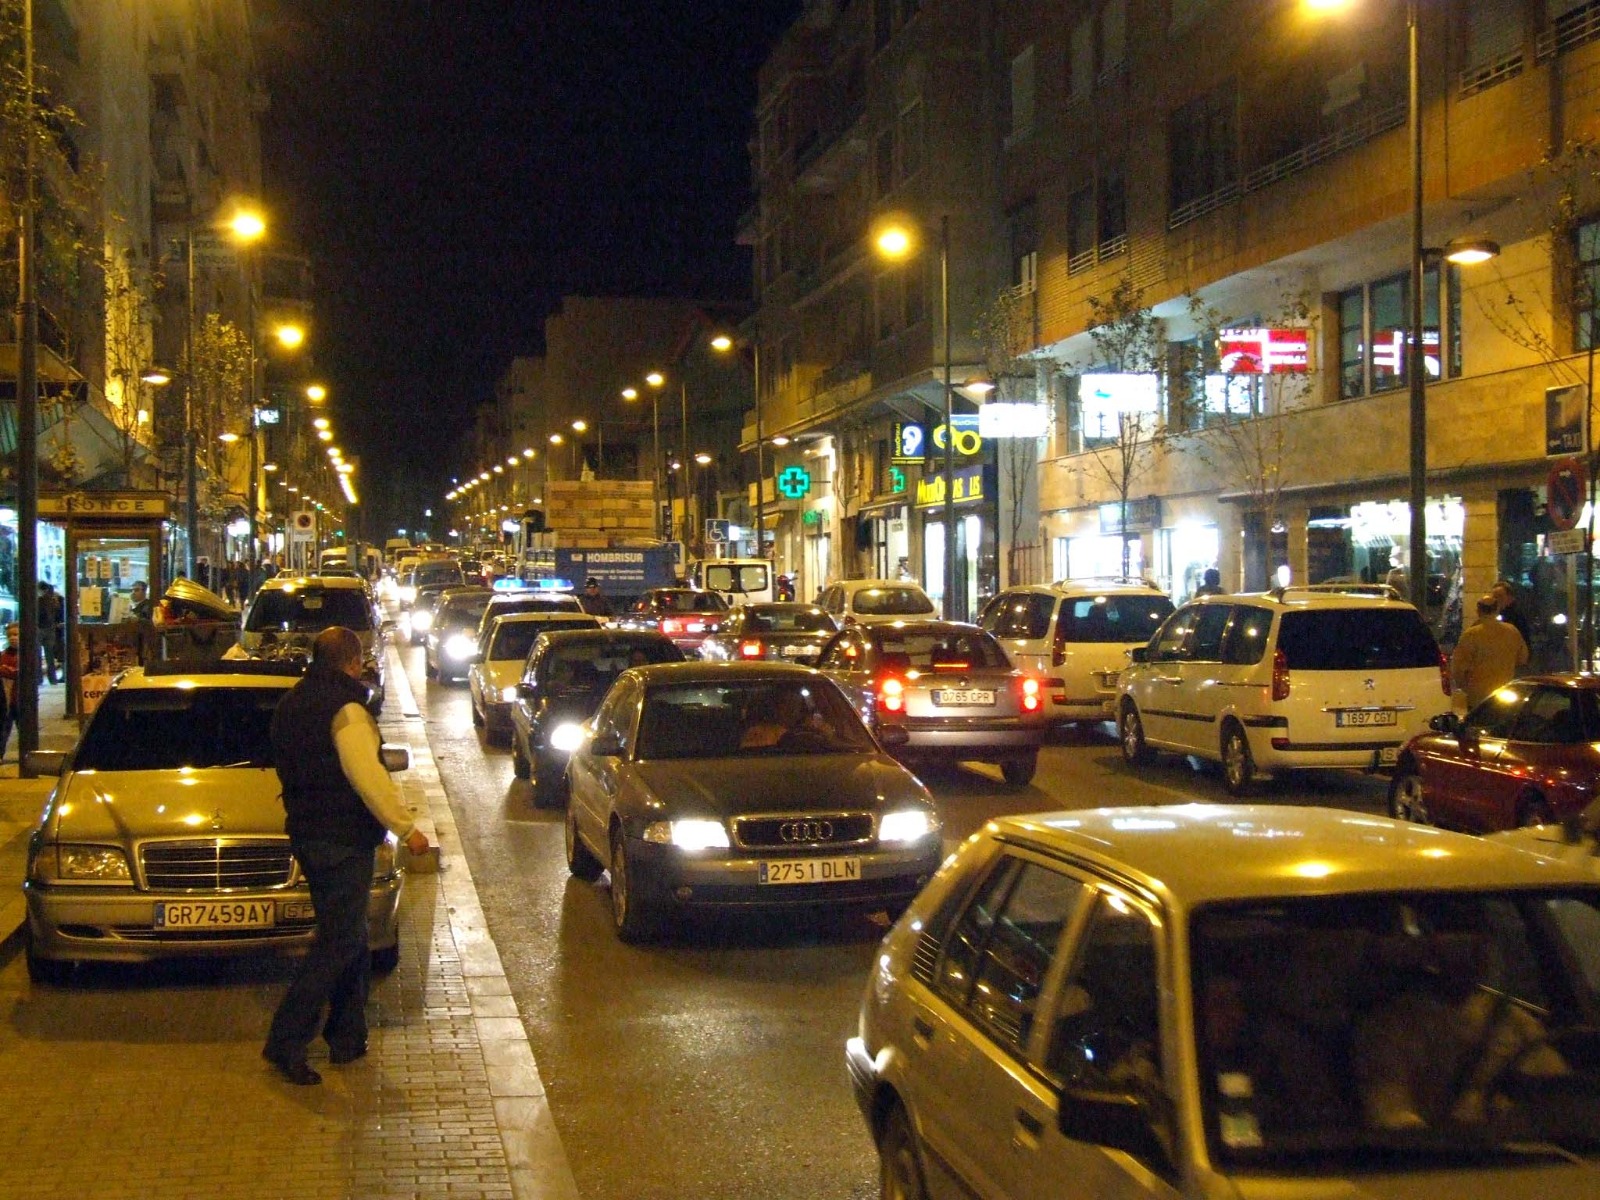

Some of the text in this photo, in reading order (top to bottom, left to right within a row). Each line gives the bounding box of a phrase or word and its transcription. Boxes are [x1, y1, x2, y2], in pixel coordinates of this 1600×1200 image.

[587, 552, 643, 563] HOMBRISUR
[770, 861, 855, 881] 2751 DLN
